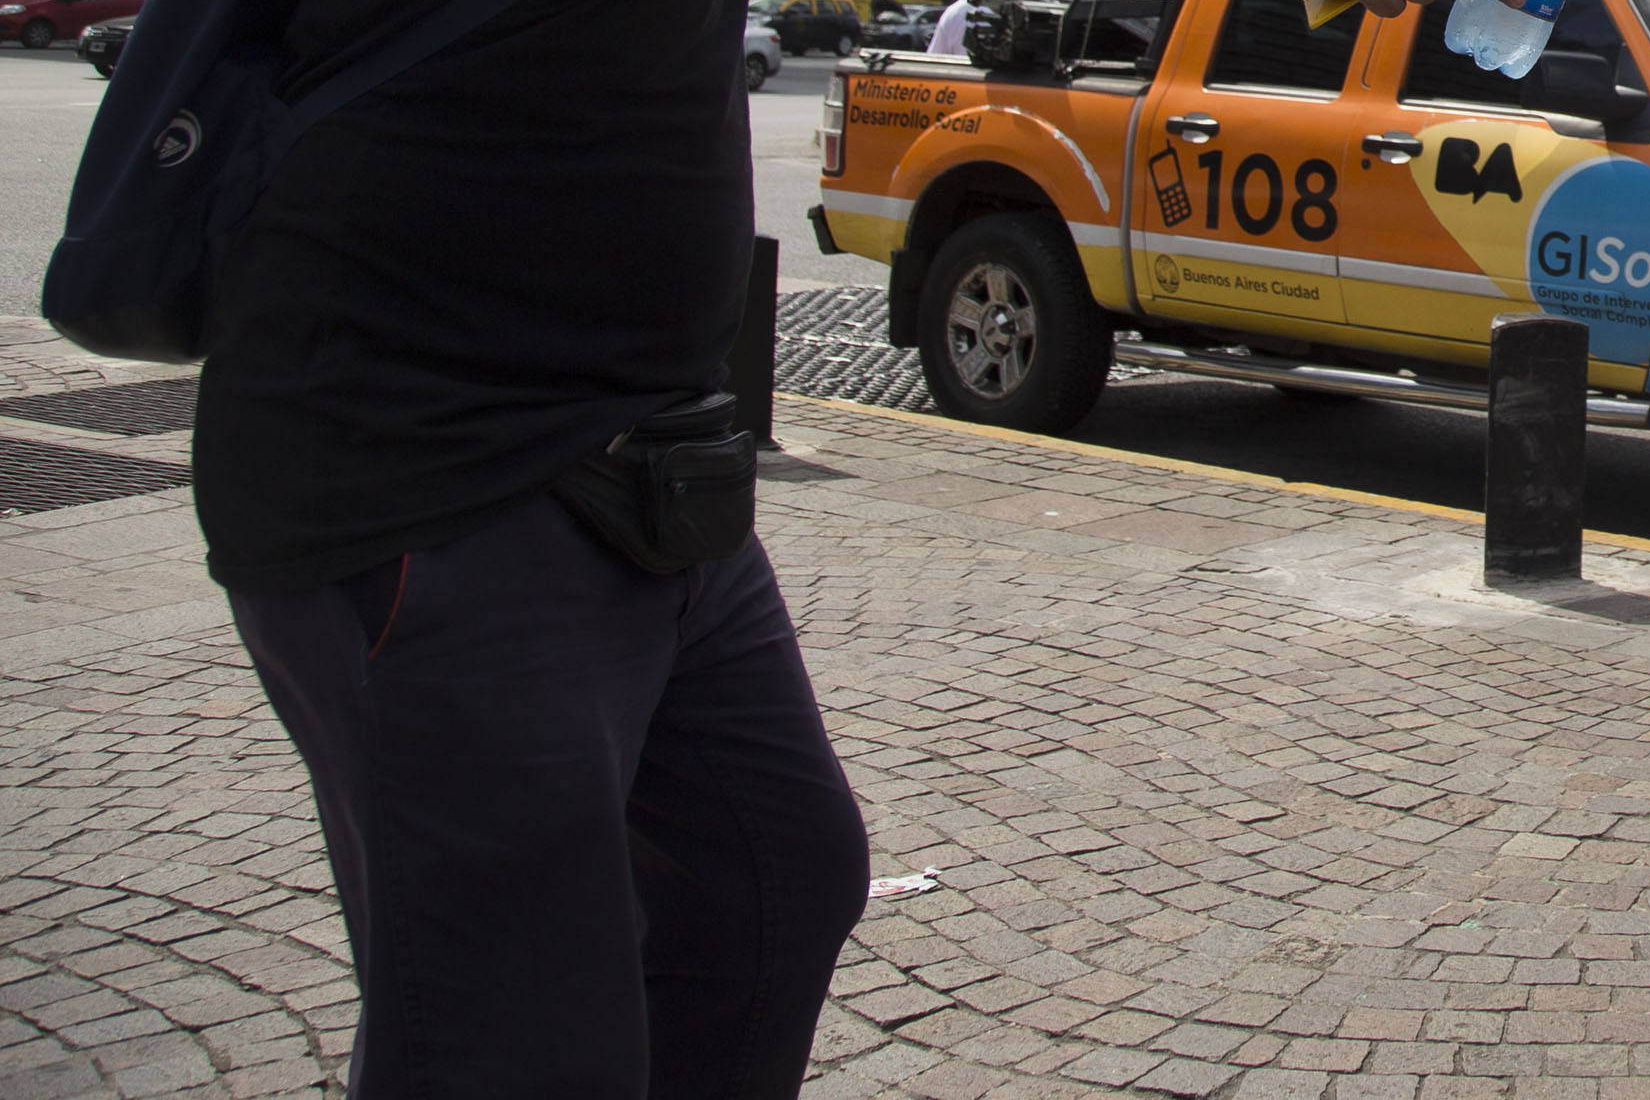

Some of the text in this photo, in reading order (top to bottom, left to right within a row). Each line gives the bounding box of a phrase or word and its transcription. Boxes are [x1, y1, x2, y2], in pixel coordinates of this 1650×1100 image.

[853, 79, 957, 105] Ministerio de
[851, 105, 982, 134] Desarrollo Social
[1435, 137, 1523, 204] BA
[1197, 150, 1338, 242] 108
[1182, 267, 1320, 300] Buenos Aires Ciudad
[1537, 285, 1579, 302] Grupo
[1583, 292, 1600, 305] de
[1561, 304, 1601, 319] Social
